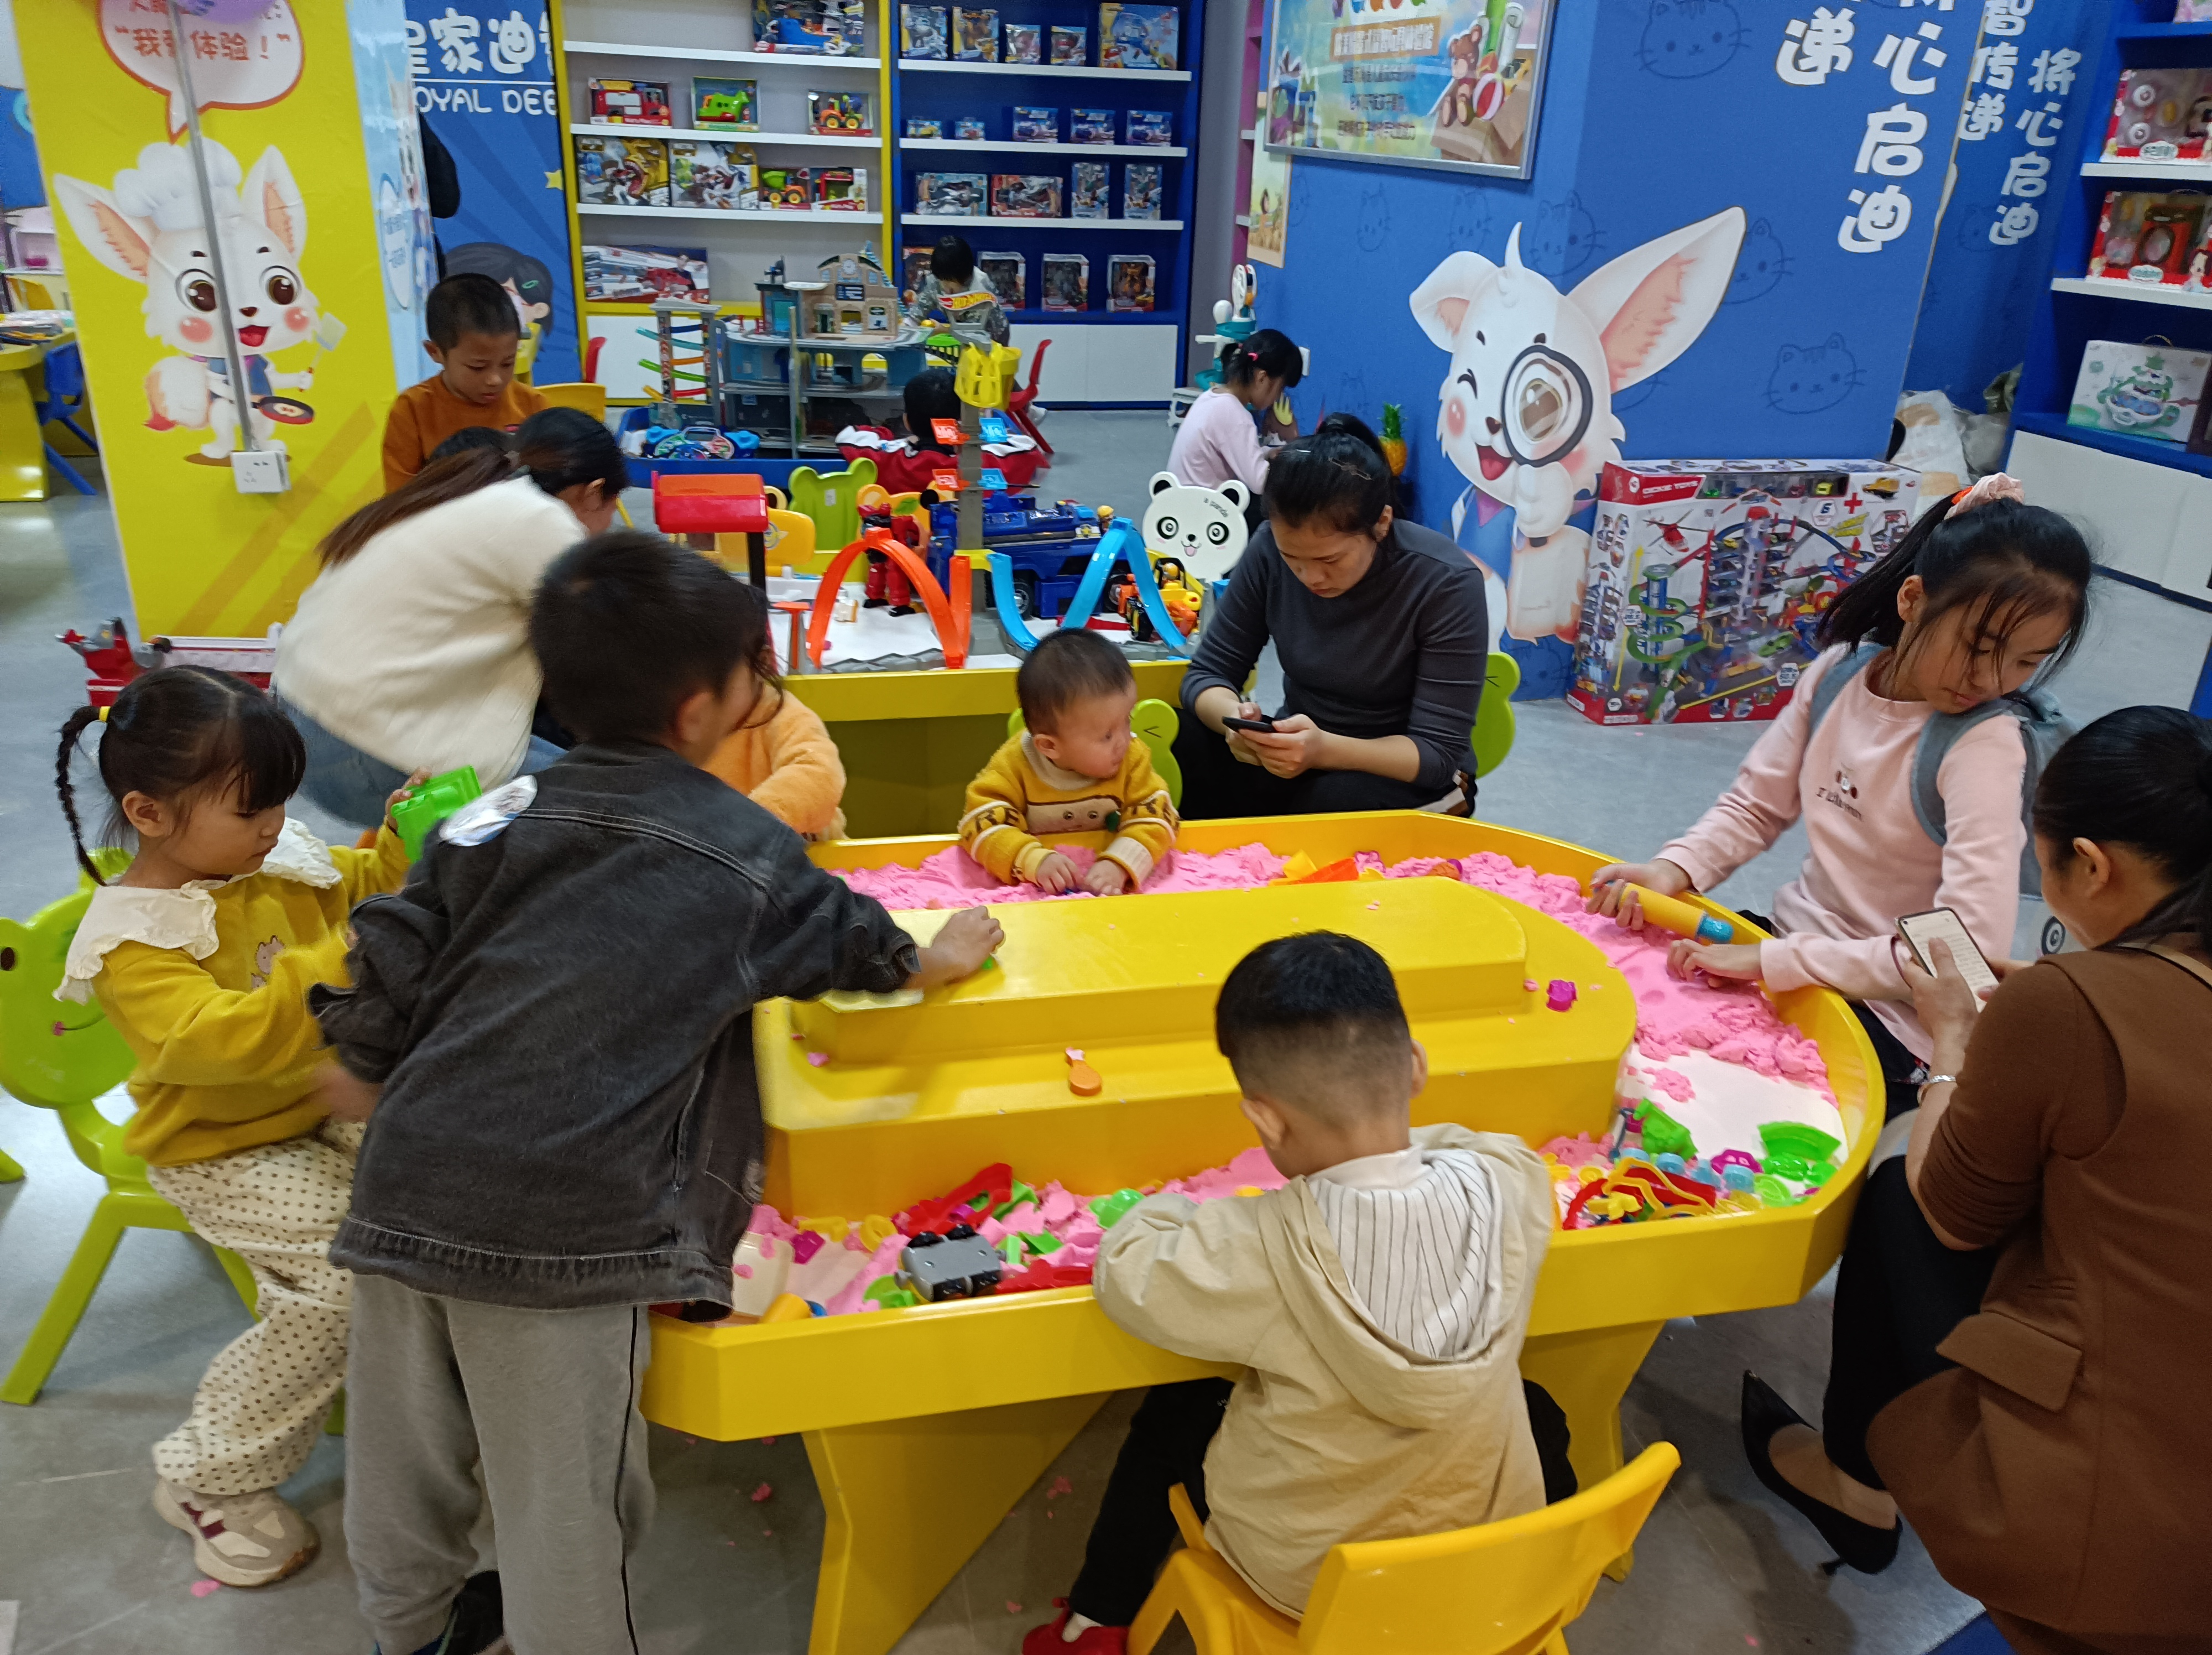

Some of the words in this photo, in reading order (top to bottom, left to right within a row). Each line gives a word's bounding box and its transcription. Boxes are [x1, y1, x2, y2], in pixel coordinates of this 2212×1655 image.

[1838, 0, 1955, 253] 心启迪
[1989, 47, 2081, 245] 将心启迪
